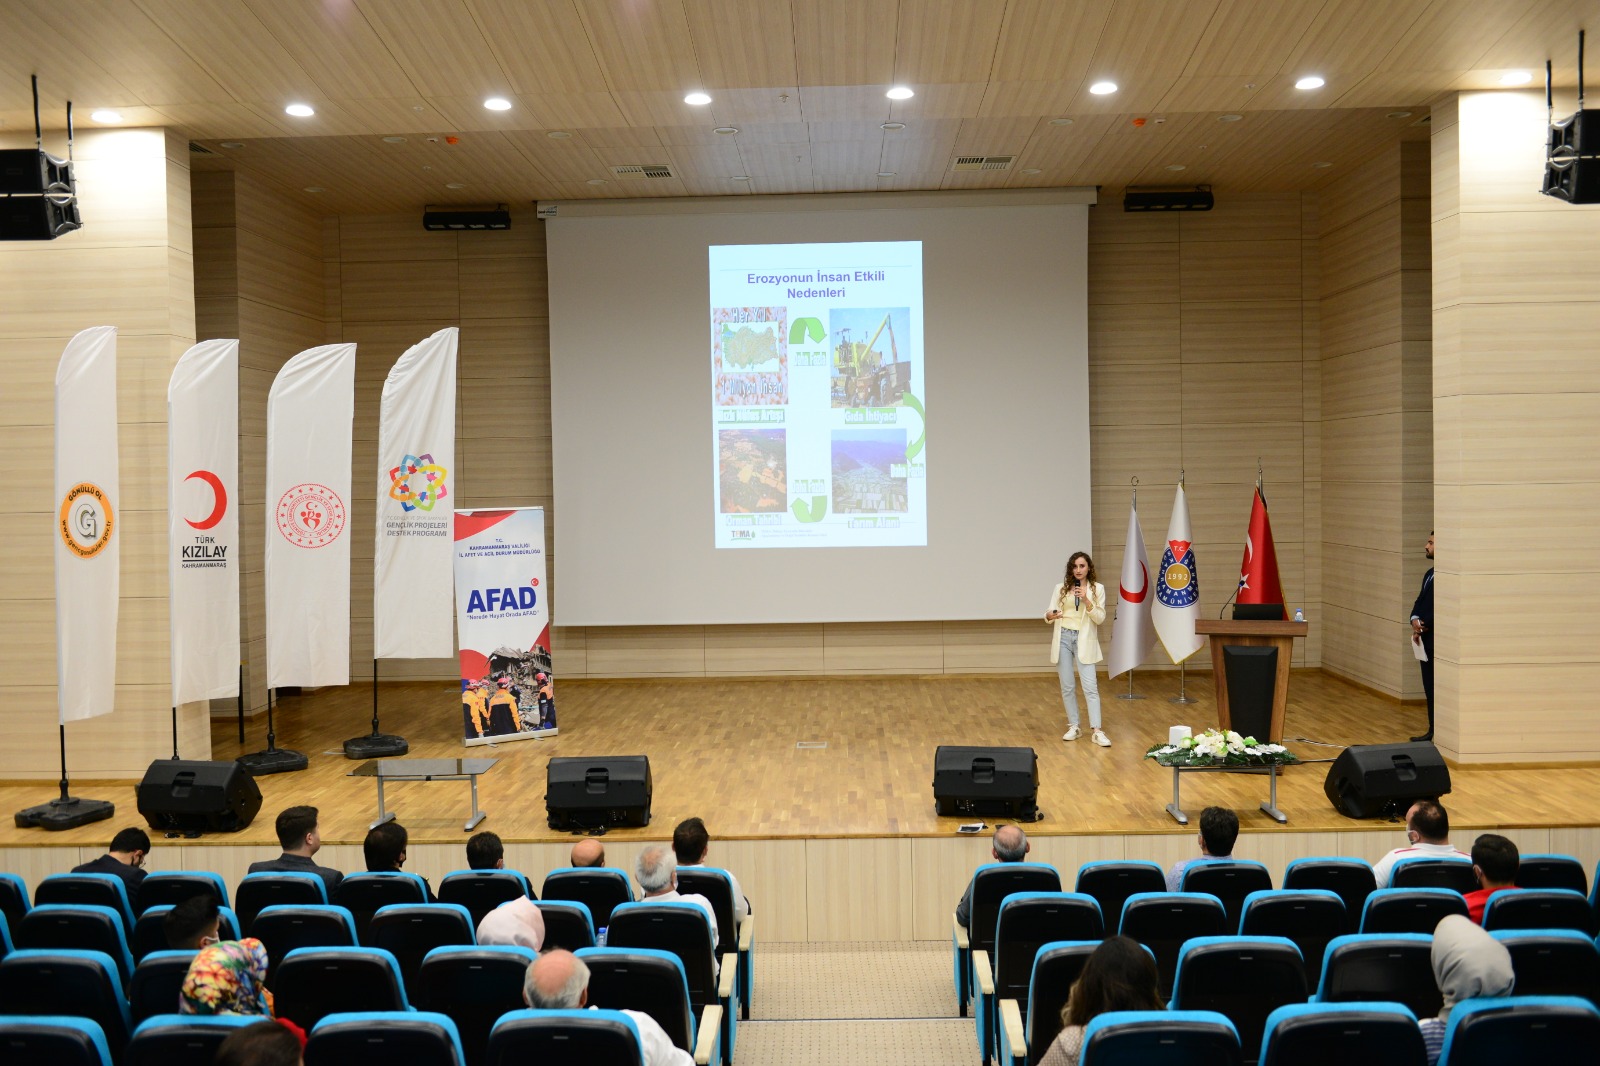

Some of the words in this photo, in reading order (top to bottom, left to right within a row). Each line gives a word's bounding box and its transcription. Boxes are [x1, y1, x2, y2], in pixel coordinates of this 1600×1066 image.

[747, 272, 813, 285] Erozyonun
[817, 270, 850, 283] İnsan
[854, 271, 885, 282] Etkili
[787, 287, 846, 299] Nedenleri
[68, 485, 95, 502] GÖNÜLLÜ
[95, 490, 102, 501] OL
[386, 521, 414, 529] GENÇLİK
[414, 521, 448, 530] PROJELERİ
[195, 535, 215, 544] TÜRK
[182, 545, 228, 558] KIZILAY
[1167, 573, 1188, 581] 1992
[466, 586, 537, 613] AFAD
